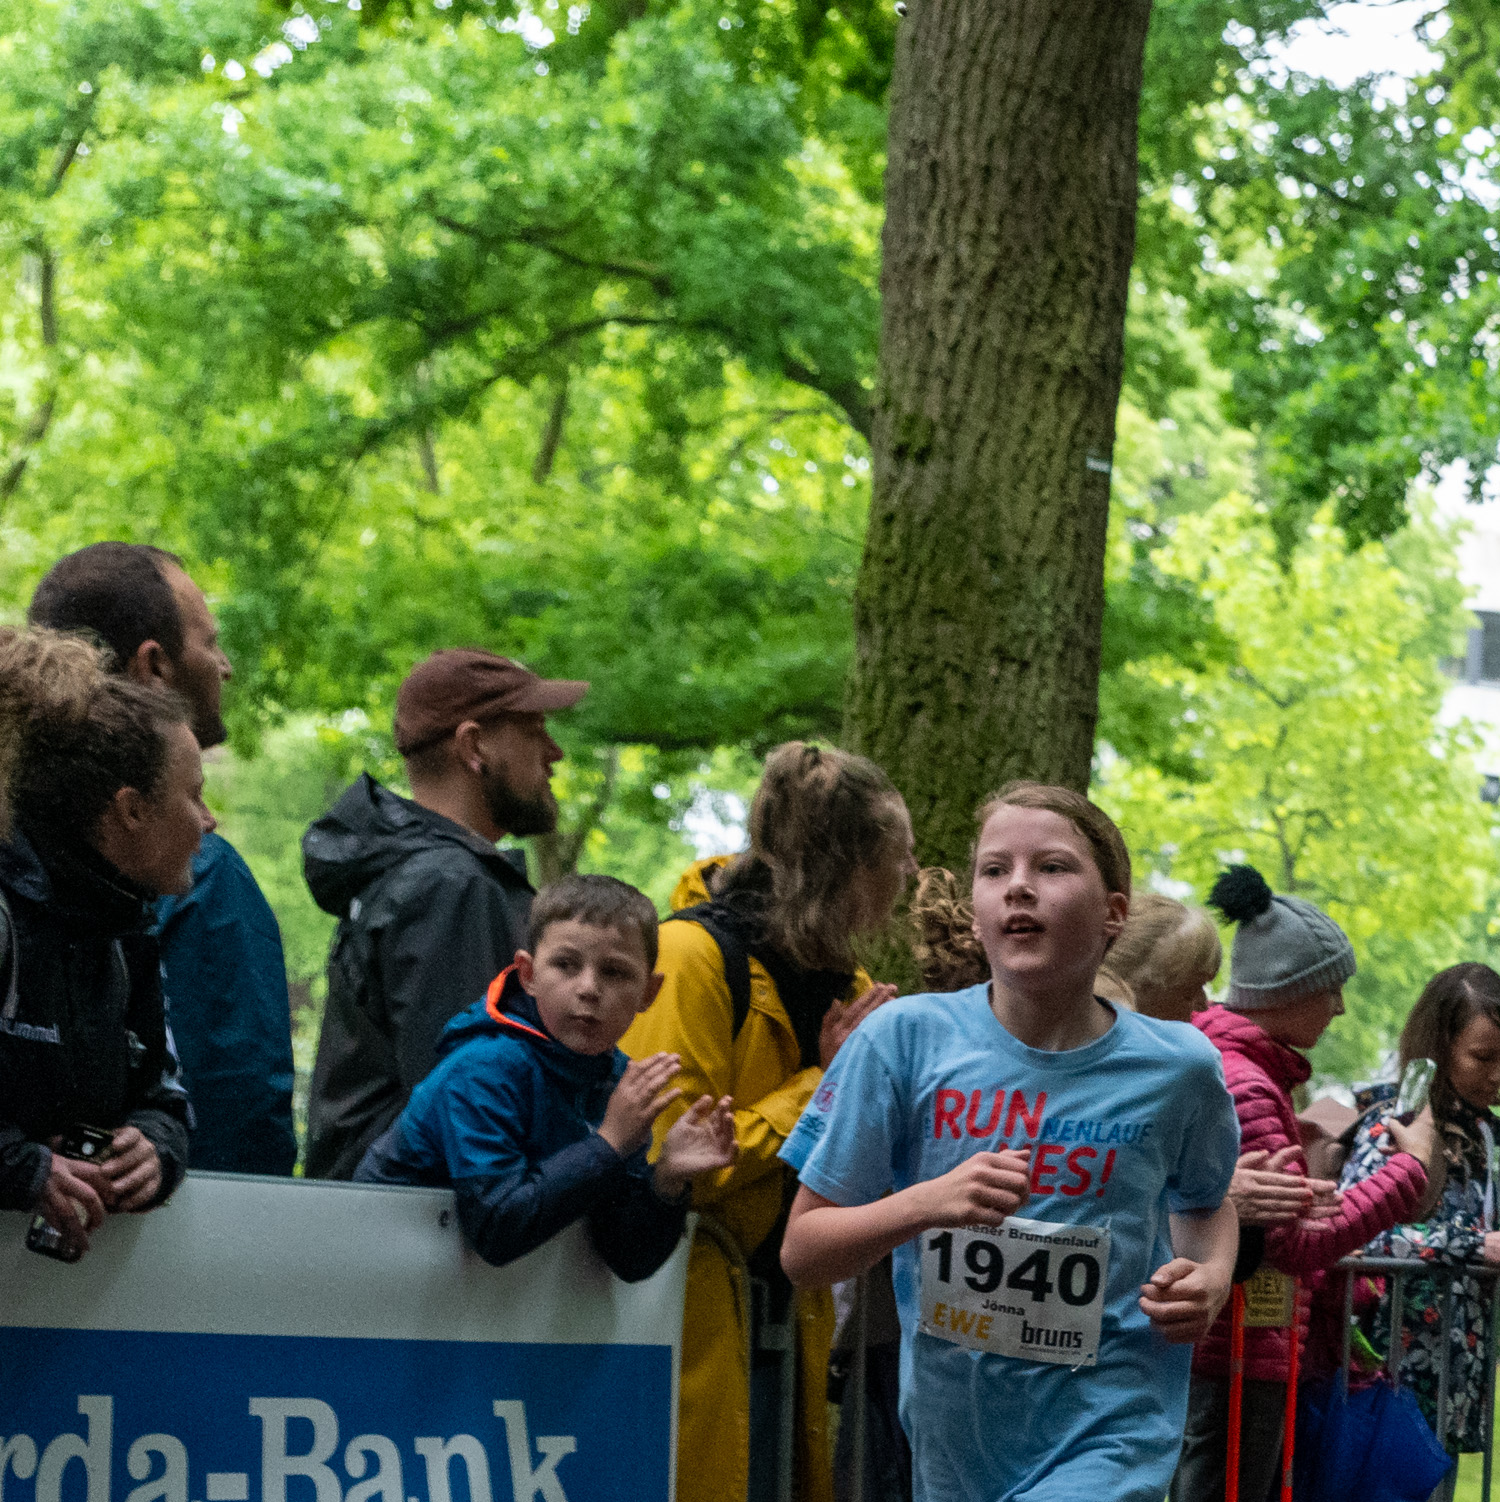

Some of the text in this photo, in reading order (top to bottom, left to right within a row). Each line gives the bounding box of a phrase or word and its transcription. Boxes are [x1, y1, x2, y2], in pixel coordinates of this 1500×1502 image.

[934, 1088, 1048, 1139] RUN
[999, 1143, 1117, 1197] ES!
[1008, 1228, 1100, 1248] Brunnenlauf
[928, 1231, 1101, 1306] 1940
[933, 1302, 1083, 1348] EWE bruns
[982, 1299, 1026, 1316] Jönna
